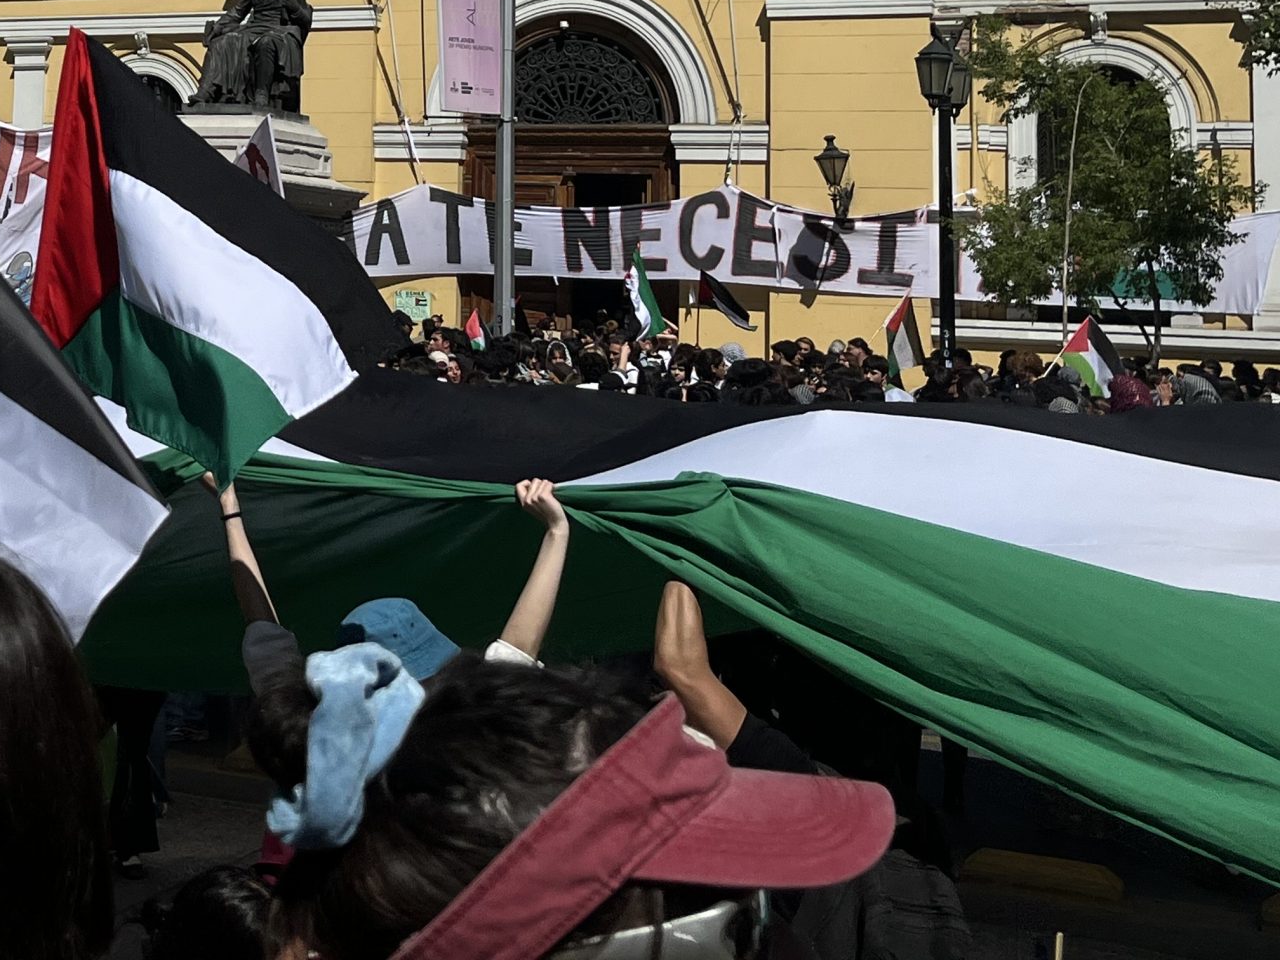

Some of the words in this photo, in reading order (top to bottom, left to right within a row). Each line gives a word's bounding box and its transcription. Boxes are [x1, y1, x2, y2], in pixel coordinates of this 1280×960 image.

[466, 1, 476, 26] AL
[429, 186, 533, 267] TE
[561, 191, 986, 293] NECESIT
